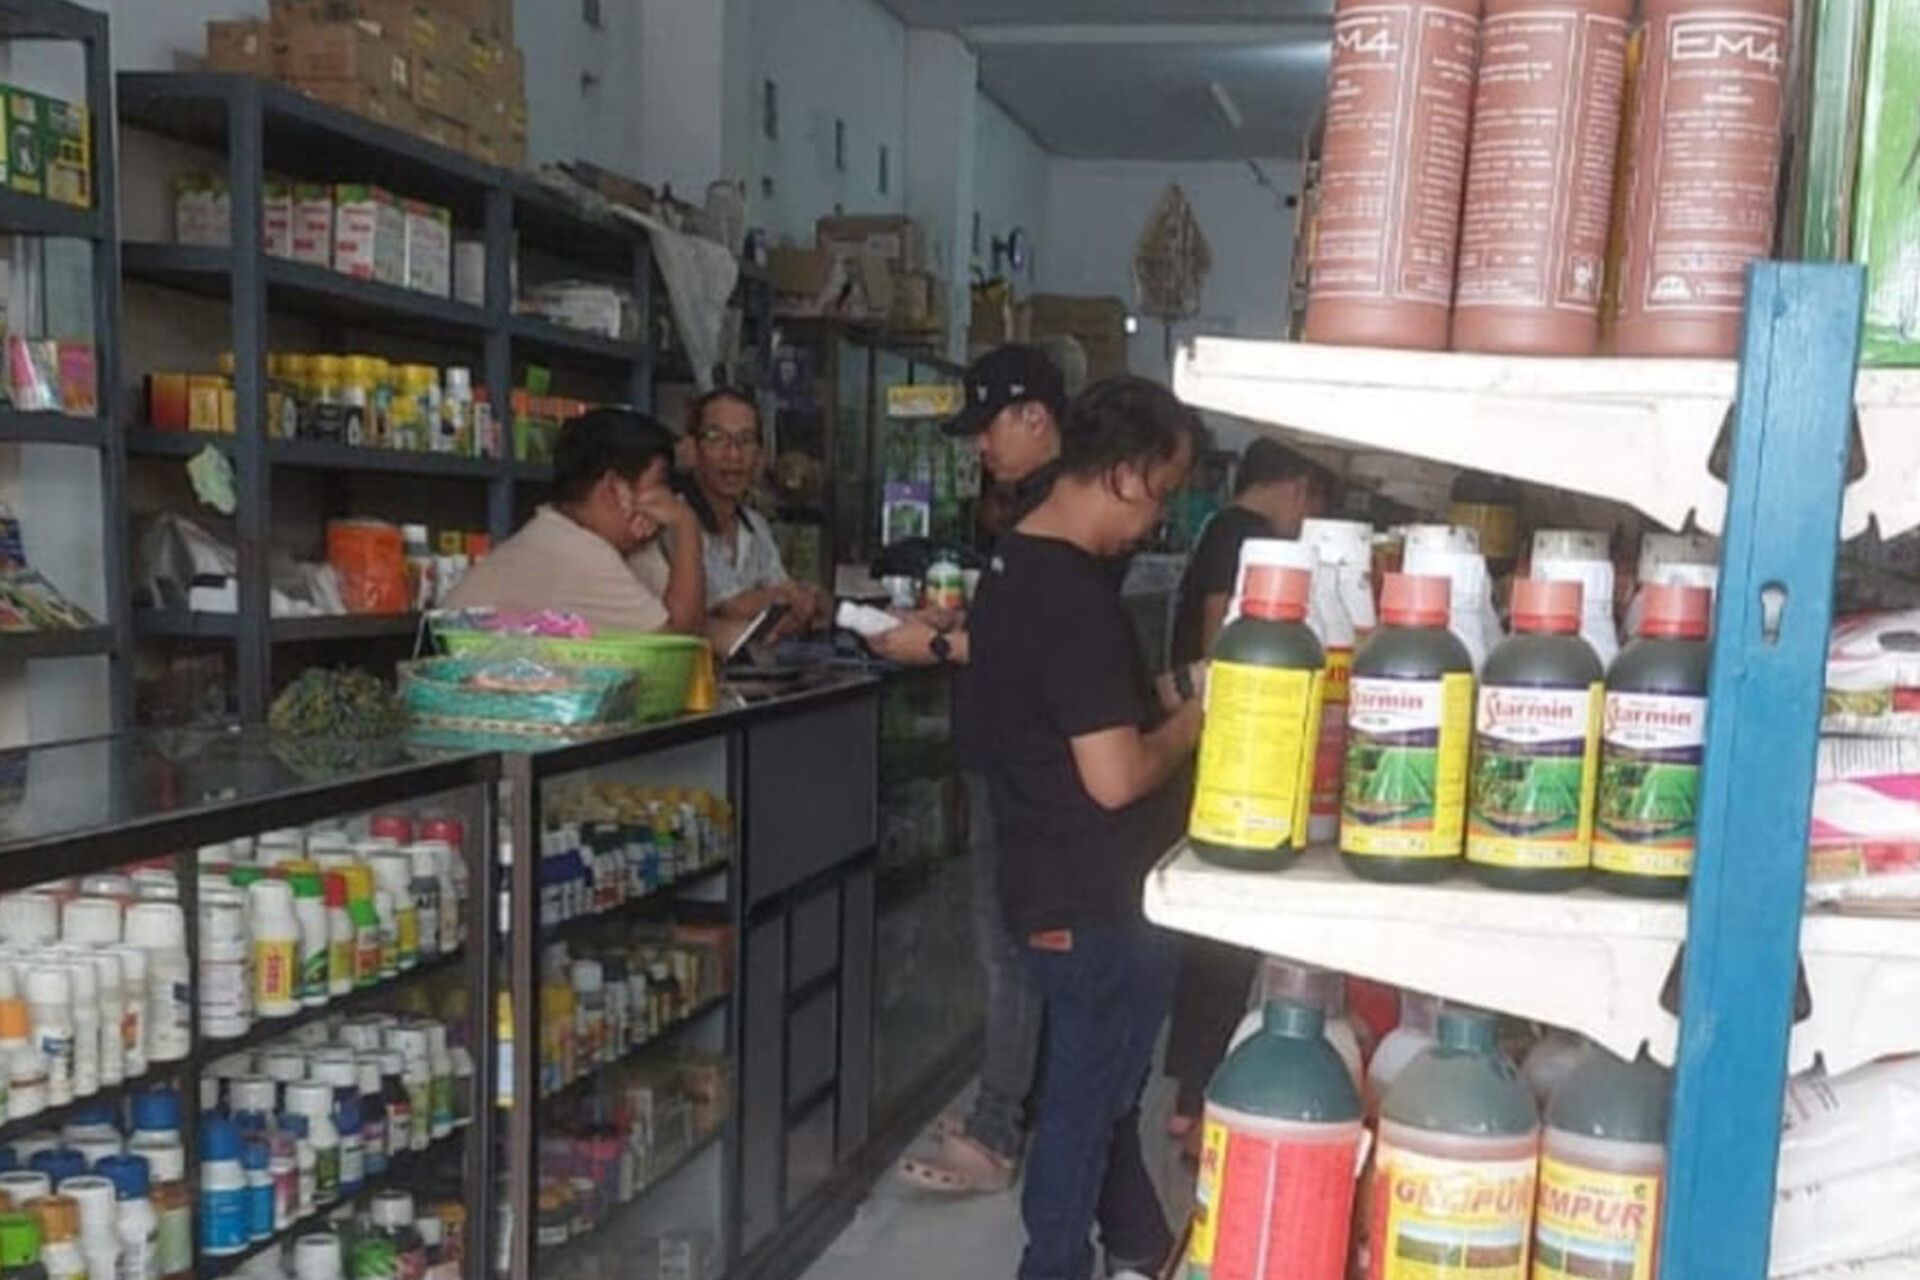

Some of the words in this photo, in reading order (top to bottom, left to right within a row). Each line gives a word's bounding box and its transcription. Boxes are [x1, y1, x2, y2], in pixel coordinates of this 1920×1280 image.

[1671, 22, 1785, 74] EM4
[1483, 690, 1574, 730] Starmin
[1606, 697, 1693, 734] Starmin
